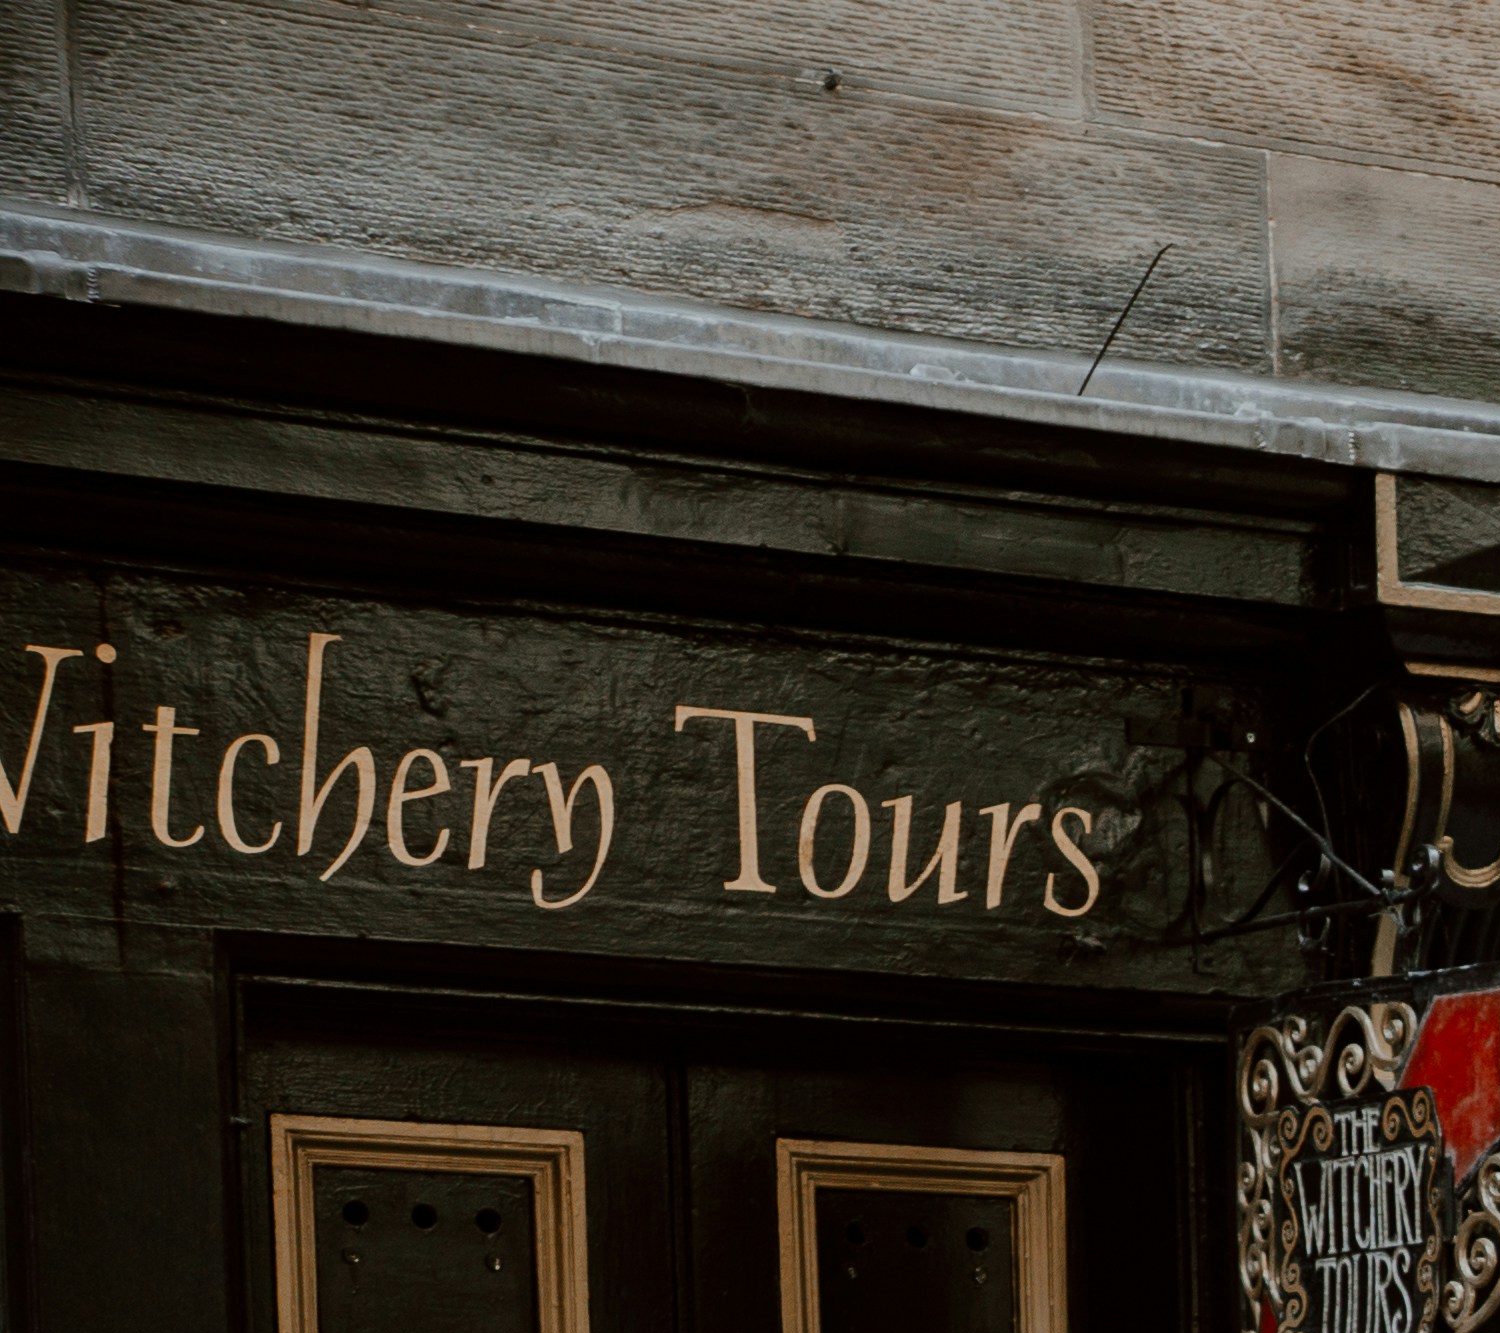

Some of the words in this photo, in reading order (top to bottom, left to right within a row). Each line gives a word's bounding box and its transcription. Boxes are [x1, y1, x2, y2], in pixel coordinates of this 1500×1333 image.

[675, 705, 1100, 918] Tours
[1334, 1107, 1381, 1156] THE
[1294, 1143, 1428, 1258] WITCHERY
